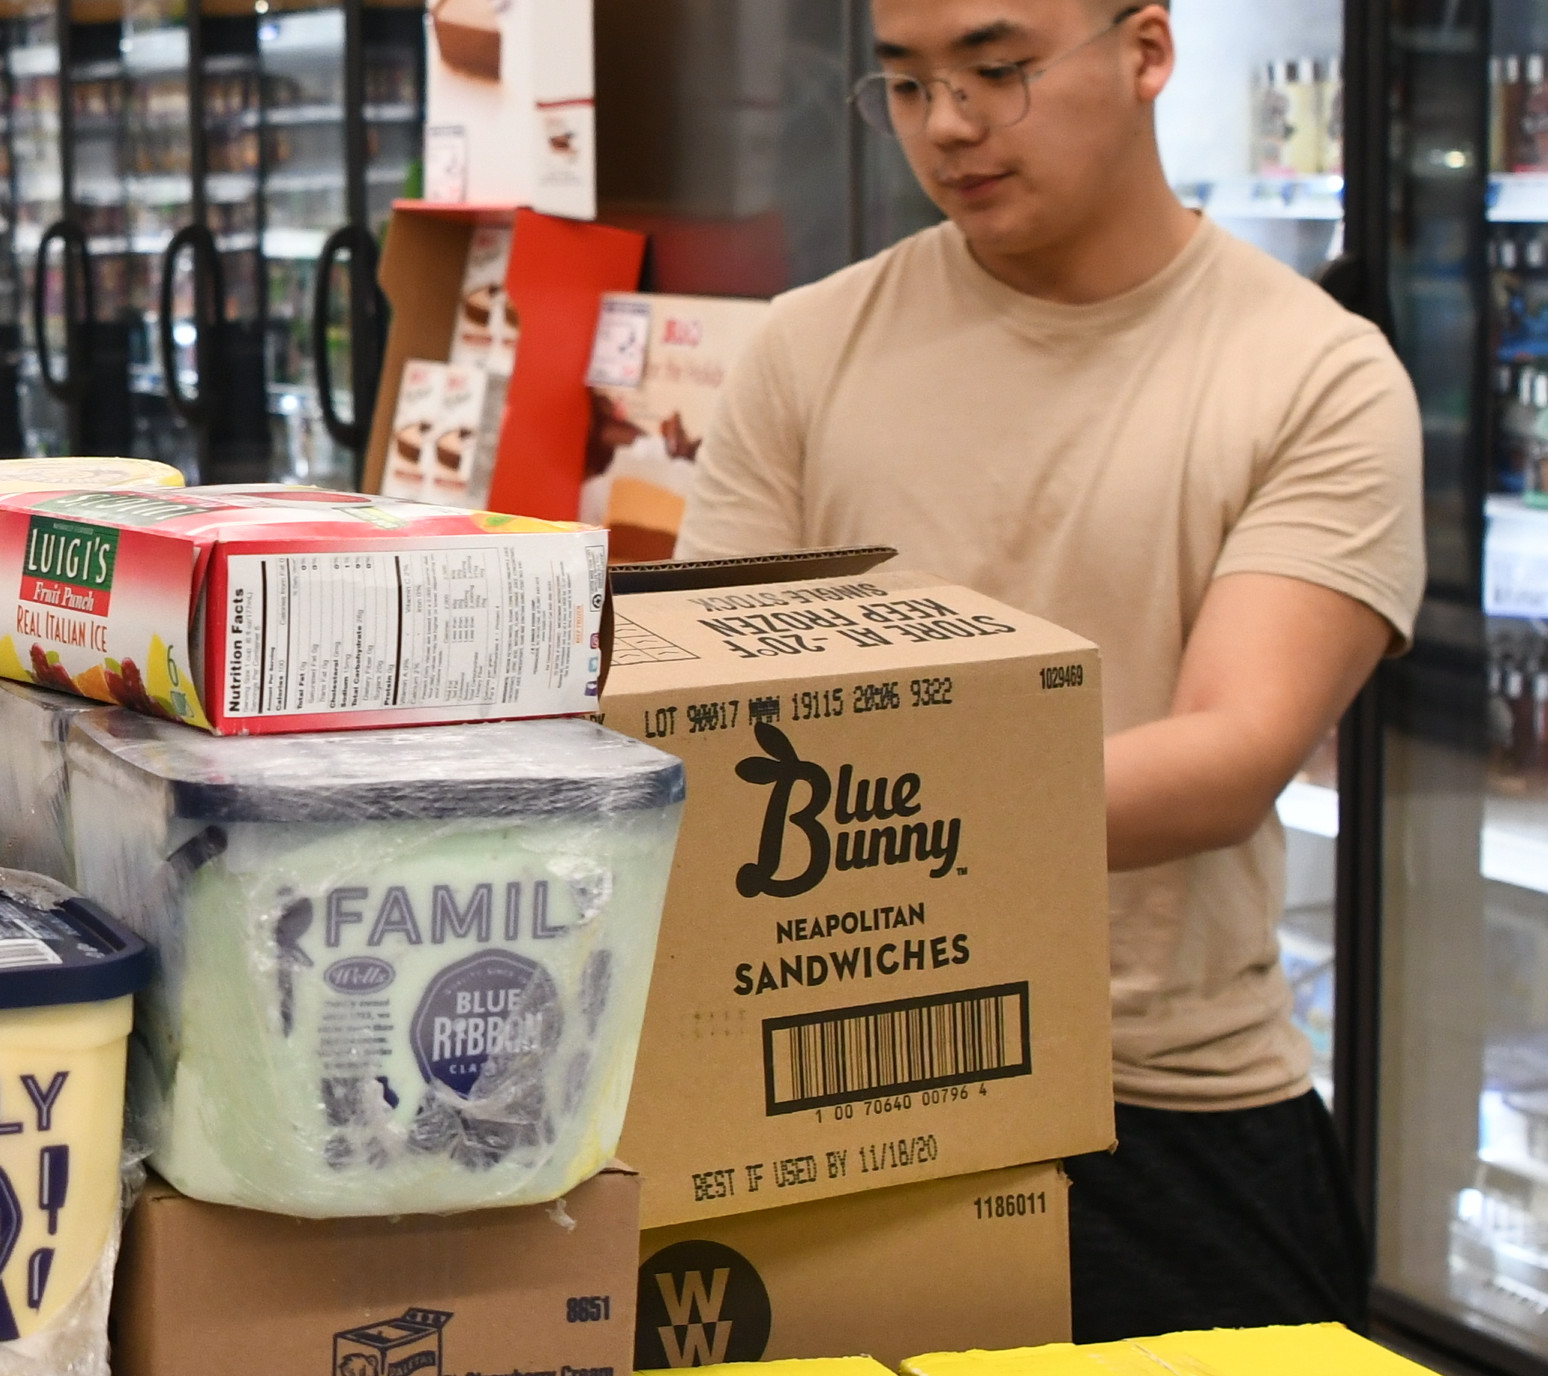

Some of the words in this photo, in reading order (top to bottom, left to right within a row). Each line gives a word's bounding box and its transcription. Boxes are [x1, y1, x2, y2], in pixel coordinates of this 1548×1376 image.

[28, 528, 110, 584] LUIGI'S
[33, 581, 60, 603] Fruit
[62, 586, 95, 611] Punch
[693, 593, 786, 612] STOCK
[790, 584, 889, 603] SINGLE
[232, 588, 243, 633] Facts
[697, 607, 858, 638] FROZEN
[858, 598, 959, 621] KEEP
[16, 605, 41, 638] REAL
[46, 611, 86, 648] ITALIAN
[90, 621, 108, 652] ICE
[839, 626, 894, 648] AT
[899, 616, 1017, 642] STORE
[167, 645, 179, 687] 6
[229, 640, 243, 712] Nutrition
[1040, 665, 1083, 689] 1029469
[645, 706, 677, 738] LOT
[792, 688, 843, 721] 19115
[910, 677, 952, 707] 9322
[324, 880, 594, 948] FAMIL
[776, 903, 925, 943] NEAPOLITAN
[733, 933, 969, 996] SANDWICHES
[456, 989, 522, 1014] BLUE
[864, 1096, 912, 1116] 70640
[922, 1088, 968, 1106] 00796
[692, 1168, 735, 1202] BEST
[745, 1164, 764, 1192] IF
[773, 1155, 817, 1188] USED
[826, 1150, 847, 1178] BY
[973, 1192, 1046, 1219] 1186011
[566, 1296, 610, 1323] 8651
